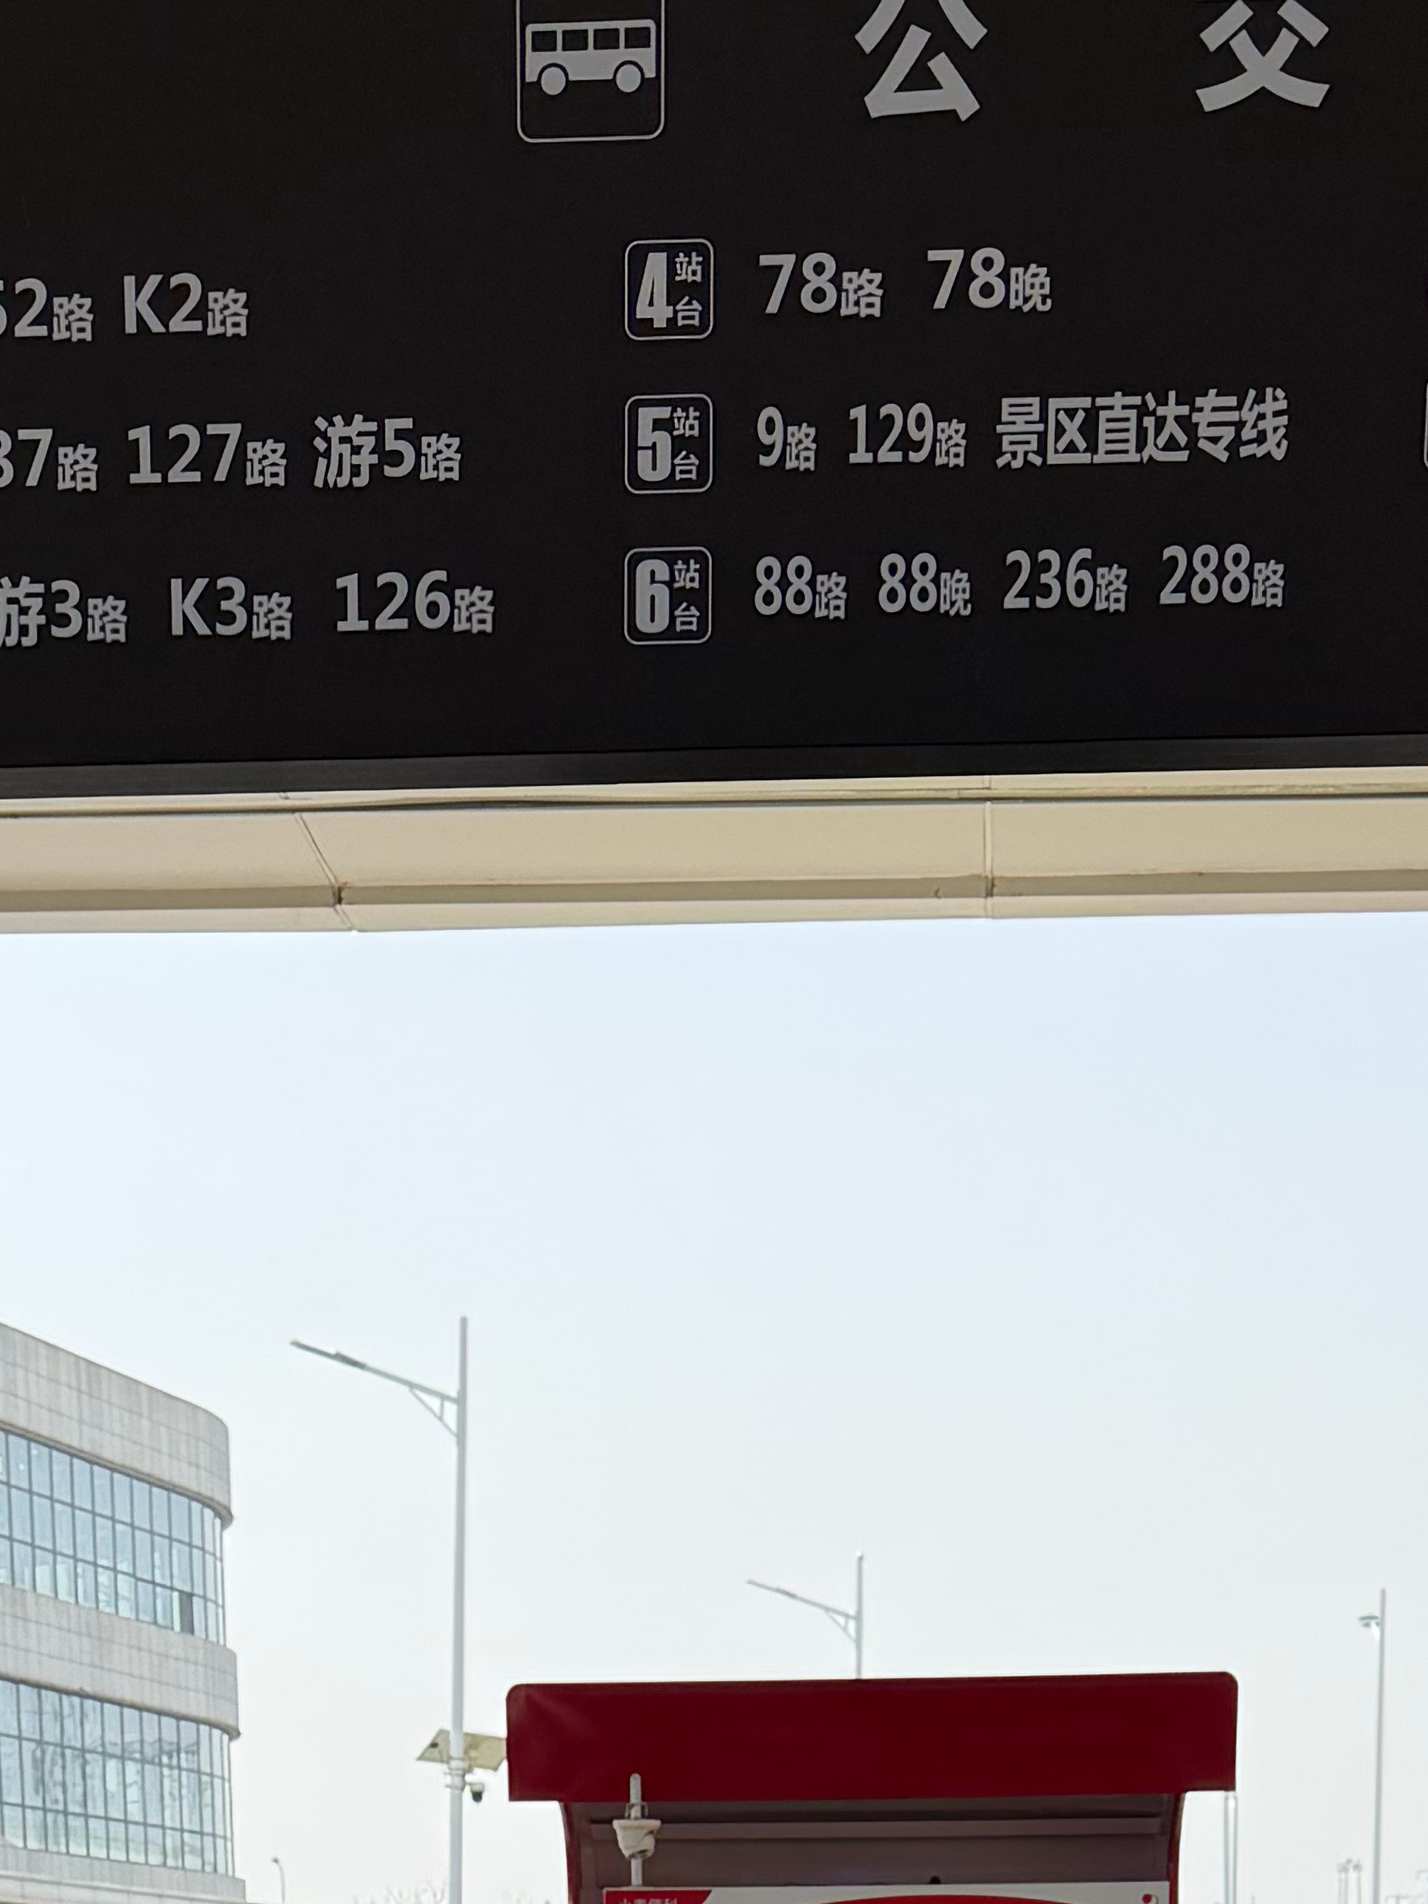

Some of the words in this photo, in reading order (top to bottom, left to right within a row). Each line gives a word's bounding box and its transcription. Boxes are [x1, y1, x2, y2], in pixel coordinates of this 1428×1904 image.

[123, 273, 249, 338] K2路
[759, 253, 883, 318] 78路
[928, 247, 1052, 313] 78晚
[128, 423, 288, 488] 127路
[313, 415, 462, 490] 游5路
[757, 407, 817, 472] 9路
[848, 403, 967, 469] 129路
[996, 388, 1289, 470] 景区直达专线
[171, 578, 293, 641] K3路
[335, 572, 495, 635] 126路
[754, 556, 848, 620] 88路
[878, 553, 971, 616] 88晚
[1003, 548, 1128, 613] 236路
[1160, 544, 1284, 608] 288路
